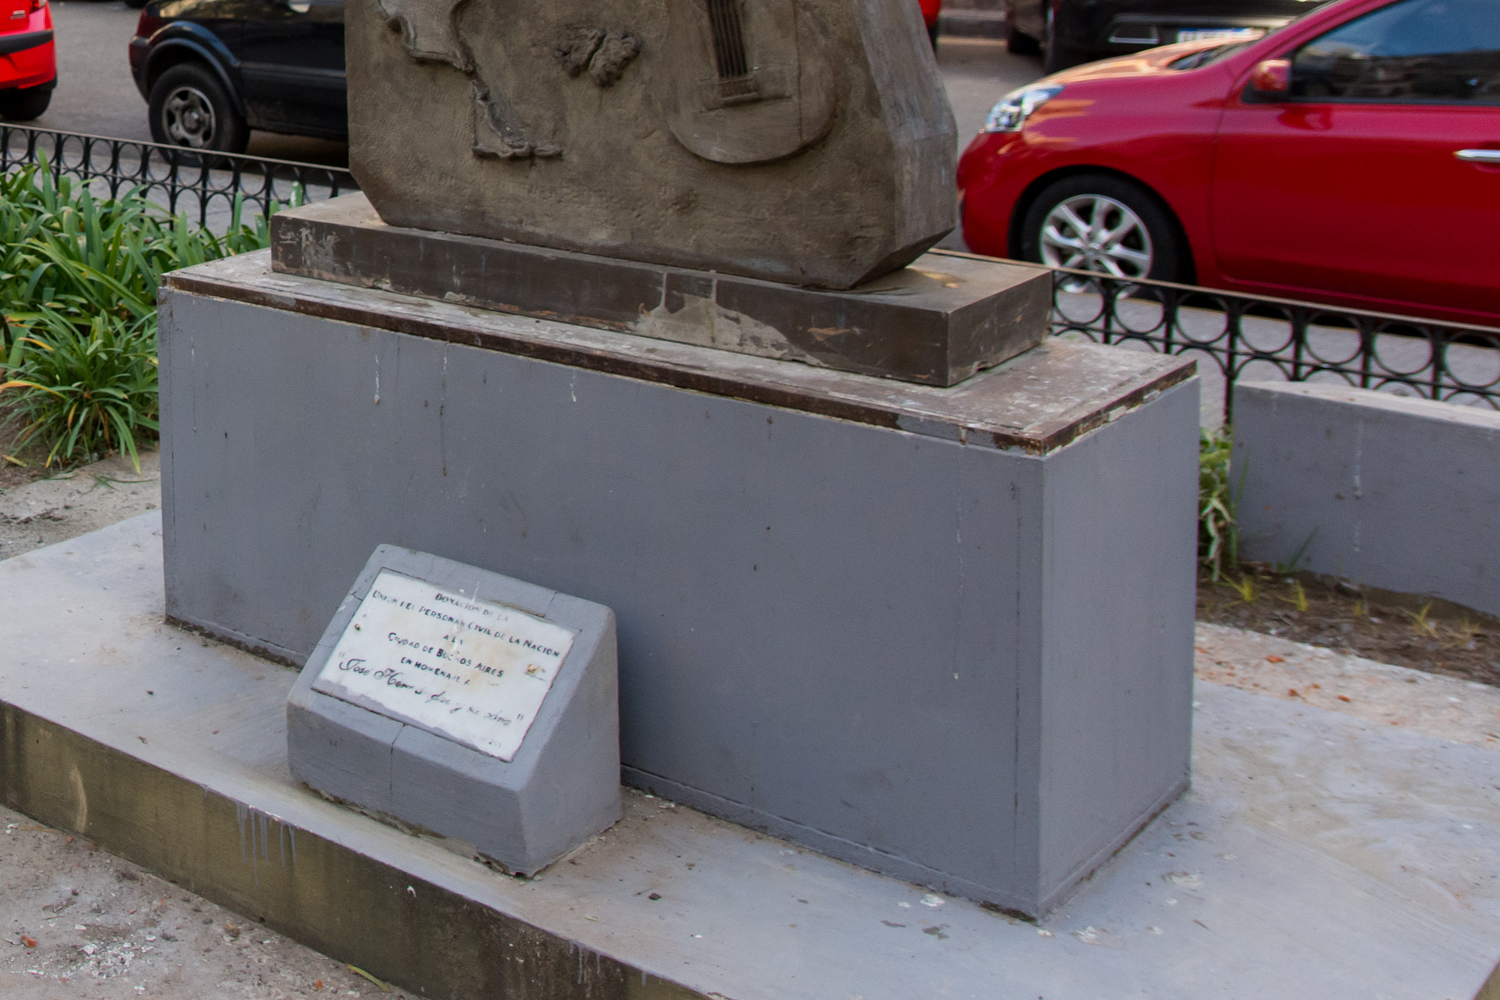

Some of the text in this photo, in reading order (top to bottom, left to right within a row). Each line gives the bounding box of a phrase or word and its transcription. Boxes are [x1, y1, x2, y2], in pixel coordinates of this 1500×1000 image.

[387, 631, 505, 678] CIUDAD DE BUEOS AIRES
[467, 621, 491, 636] CIVIL
[509, 635, 521, 645] LA
[523, 639, 561, 658] NACION
[400, 655, 413, 666] EN
